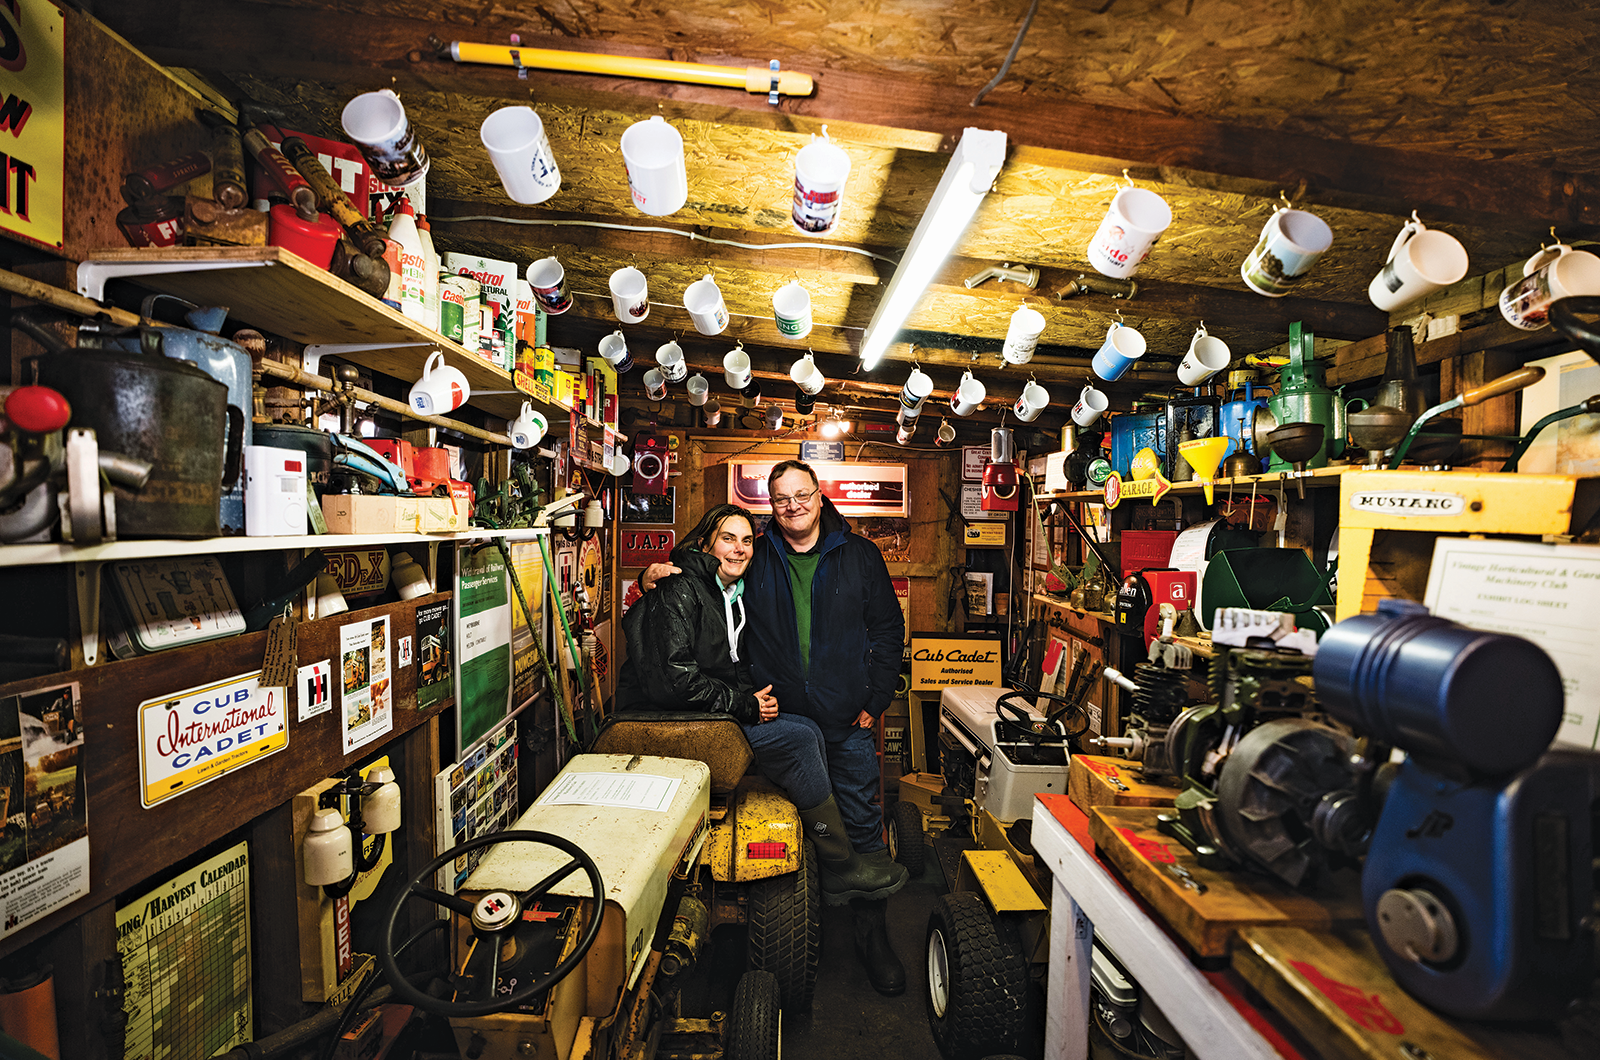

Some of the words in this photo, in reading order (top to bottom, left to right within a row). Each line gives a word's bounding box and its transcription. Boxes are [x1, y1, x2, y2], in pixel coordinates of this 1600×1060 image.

[1121, 482, 1153, 496] GARAGE
[1359, 496, 1454, 509] MUSTANG
[461, 578, 482, 590] Passenger
[482, 576, 498, 586] Services
[913, 649, 944, 662] Cub
[945, 649, 998, 663] Cadet
[940, 667, 974, 675] Authorised
[193, 688, 250, 715] CUB
[157, 691, 276, 757] International
[172, 723, 268, 768] CADET
[197, 766, 210, 774] Lawn
[215, 757, 231, 767] Garden
[231, 750, 248, 761] Tractors
[200, 854, 247, 889] CALENDAR
